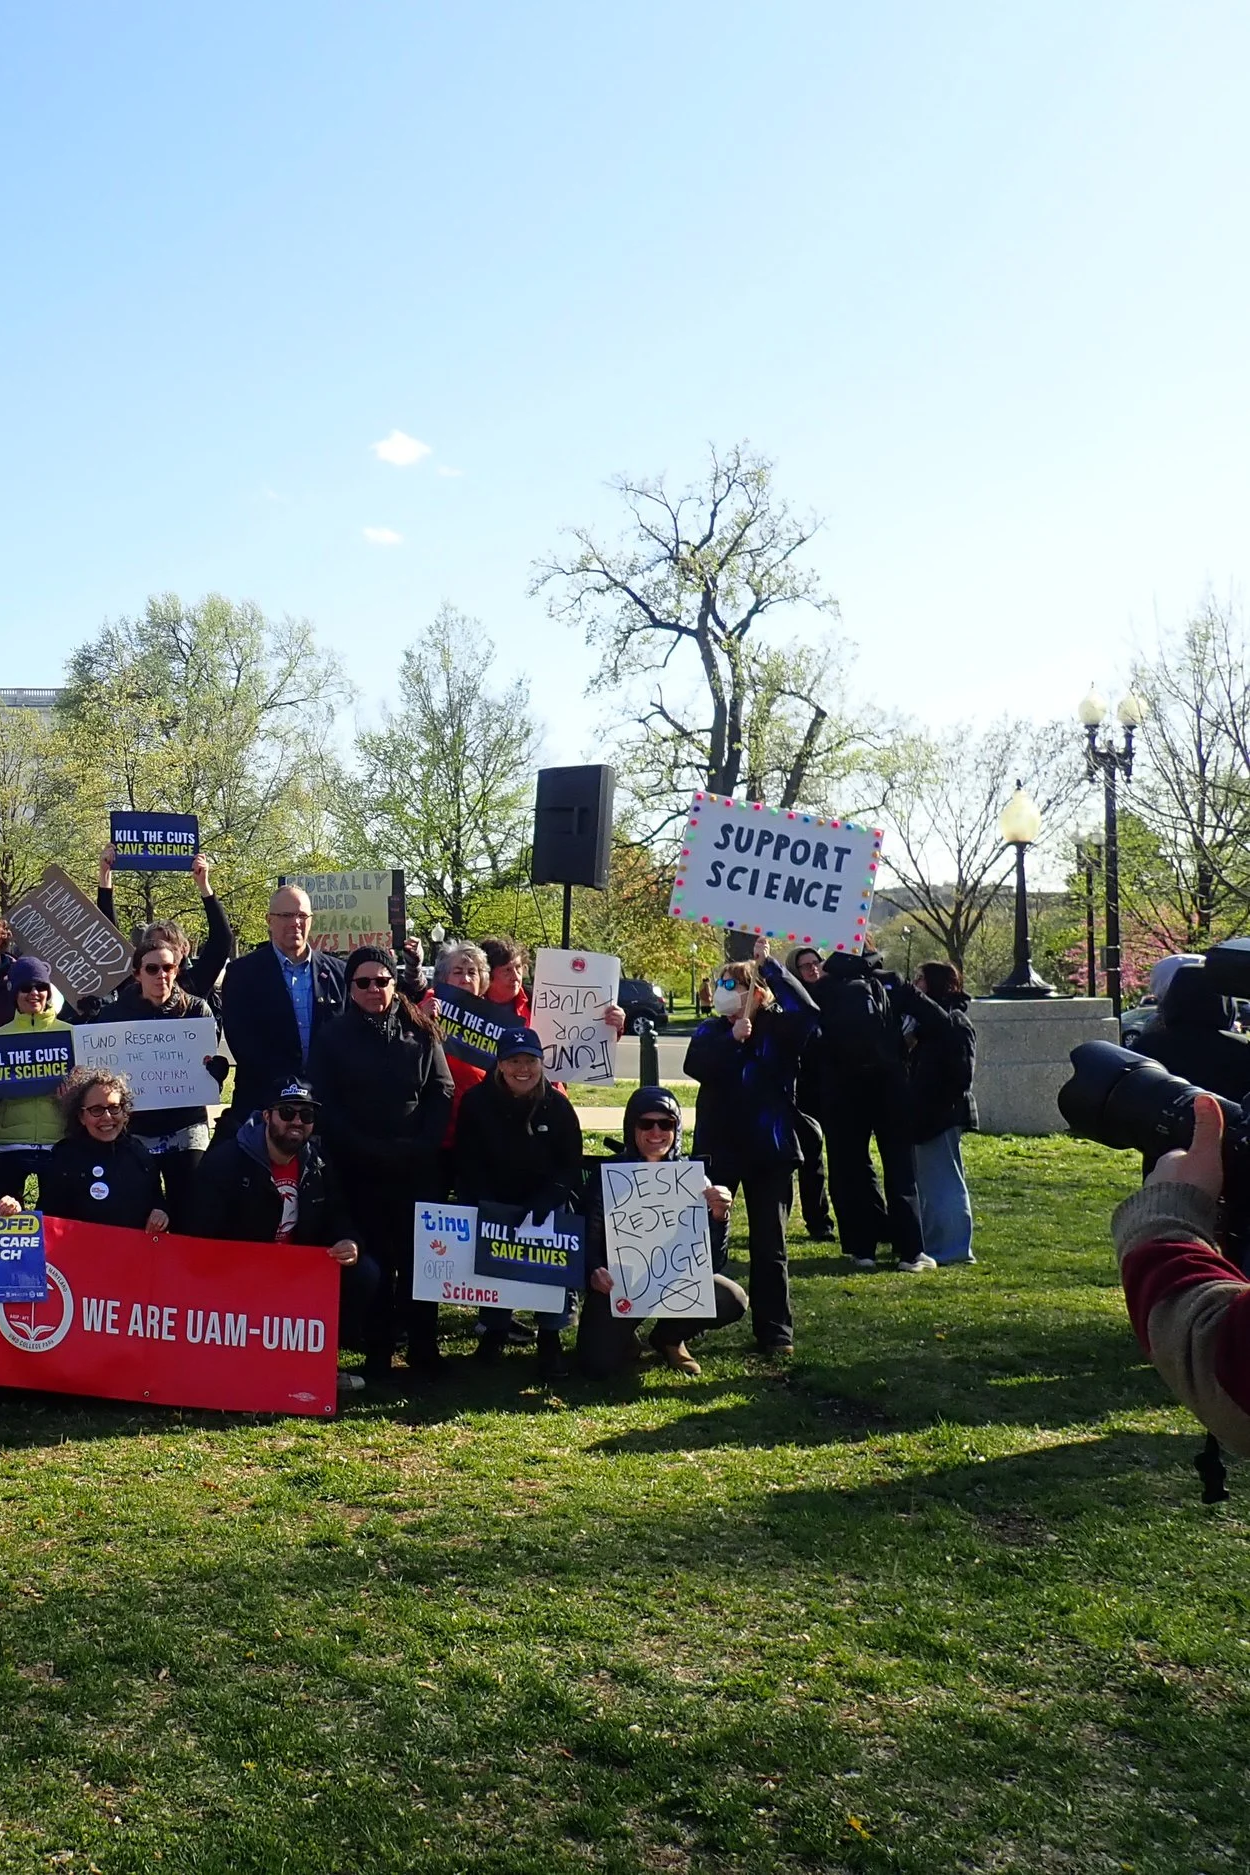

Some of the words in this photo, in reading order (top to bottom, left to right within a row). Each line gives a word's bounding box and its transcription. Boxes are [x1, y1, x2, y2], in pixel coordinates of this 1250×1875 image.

[115, 830, 139, 842] KILL
[142, 831, 163, 842] THE
[167, 832, 195, 844] CUTS
[714, 823, 851, 873] SUPPORT
[116, 844, 144, 855] SAVE
[147, 844, 194, 856] SCIENCE
[705, 860, 843, 913] SCIENCE
[310, 894, 358, 911] UNDED
[36, 880, 90, 932] HUMAN
[74, 920, 125, 966] NEED
[9, 904, 71, 962] CORPORATE
[55, 950, 102, 996] GREED
[309, 933, 340, 952] VES
[348, 932, 392, 952] LIVES
[462, 1011, 485, 1033] THE
[485, 1022, 506, 1040] CU
[552, 1019, 596, 1041] OUR
[82, 1034, 117, 1050] FUND
[125, 1030, 176, 1045] RESEARCH
[183, 1030, 196, 1040] TO
[462, 1029, 498, 1056] SCIEN
[7, 1050, 32, 1065] THE
[35, 1047, 69, 1062] CUTS
[87, 1053, 119, 1067] FIND
[126, 1053, 145, 1063] THE
[153, 1050, 192, 1064] TRUTH,
[542, 1039, 613, 1082] FUND
[14, 1062, 68, 1080] SCIENCE
[141, 1070, 188, 1081] CONFIRM
[158, 1085, 195, 1095] TRUTH
[607, 1166, 698, 1209] DESK
[421, 1210, 471, 1242] tiny
[481, 1221, 510, 1242] KILL
[610, 1204, 705, 1239] REJECT
[491, 1241, 524, 1262] SAVE
[528, 1247, 567, 1267] LIVES
[423, 1260, 455, 1280] OFF
[615, 1231, 711, 1301] DOGE!
[442, 1281, 499, 1303] Science
[82, 1296, 121, 1335] WE
[127, 1302, 178, 1342] ARE
[186, 1308, 326, 1354] UAM-UMD
[19, 1341, 42, 1350] COLLEGE
